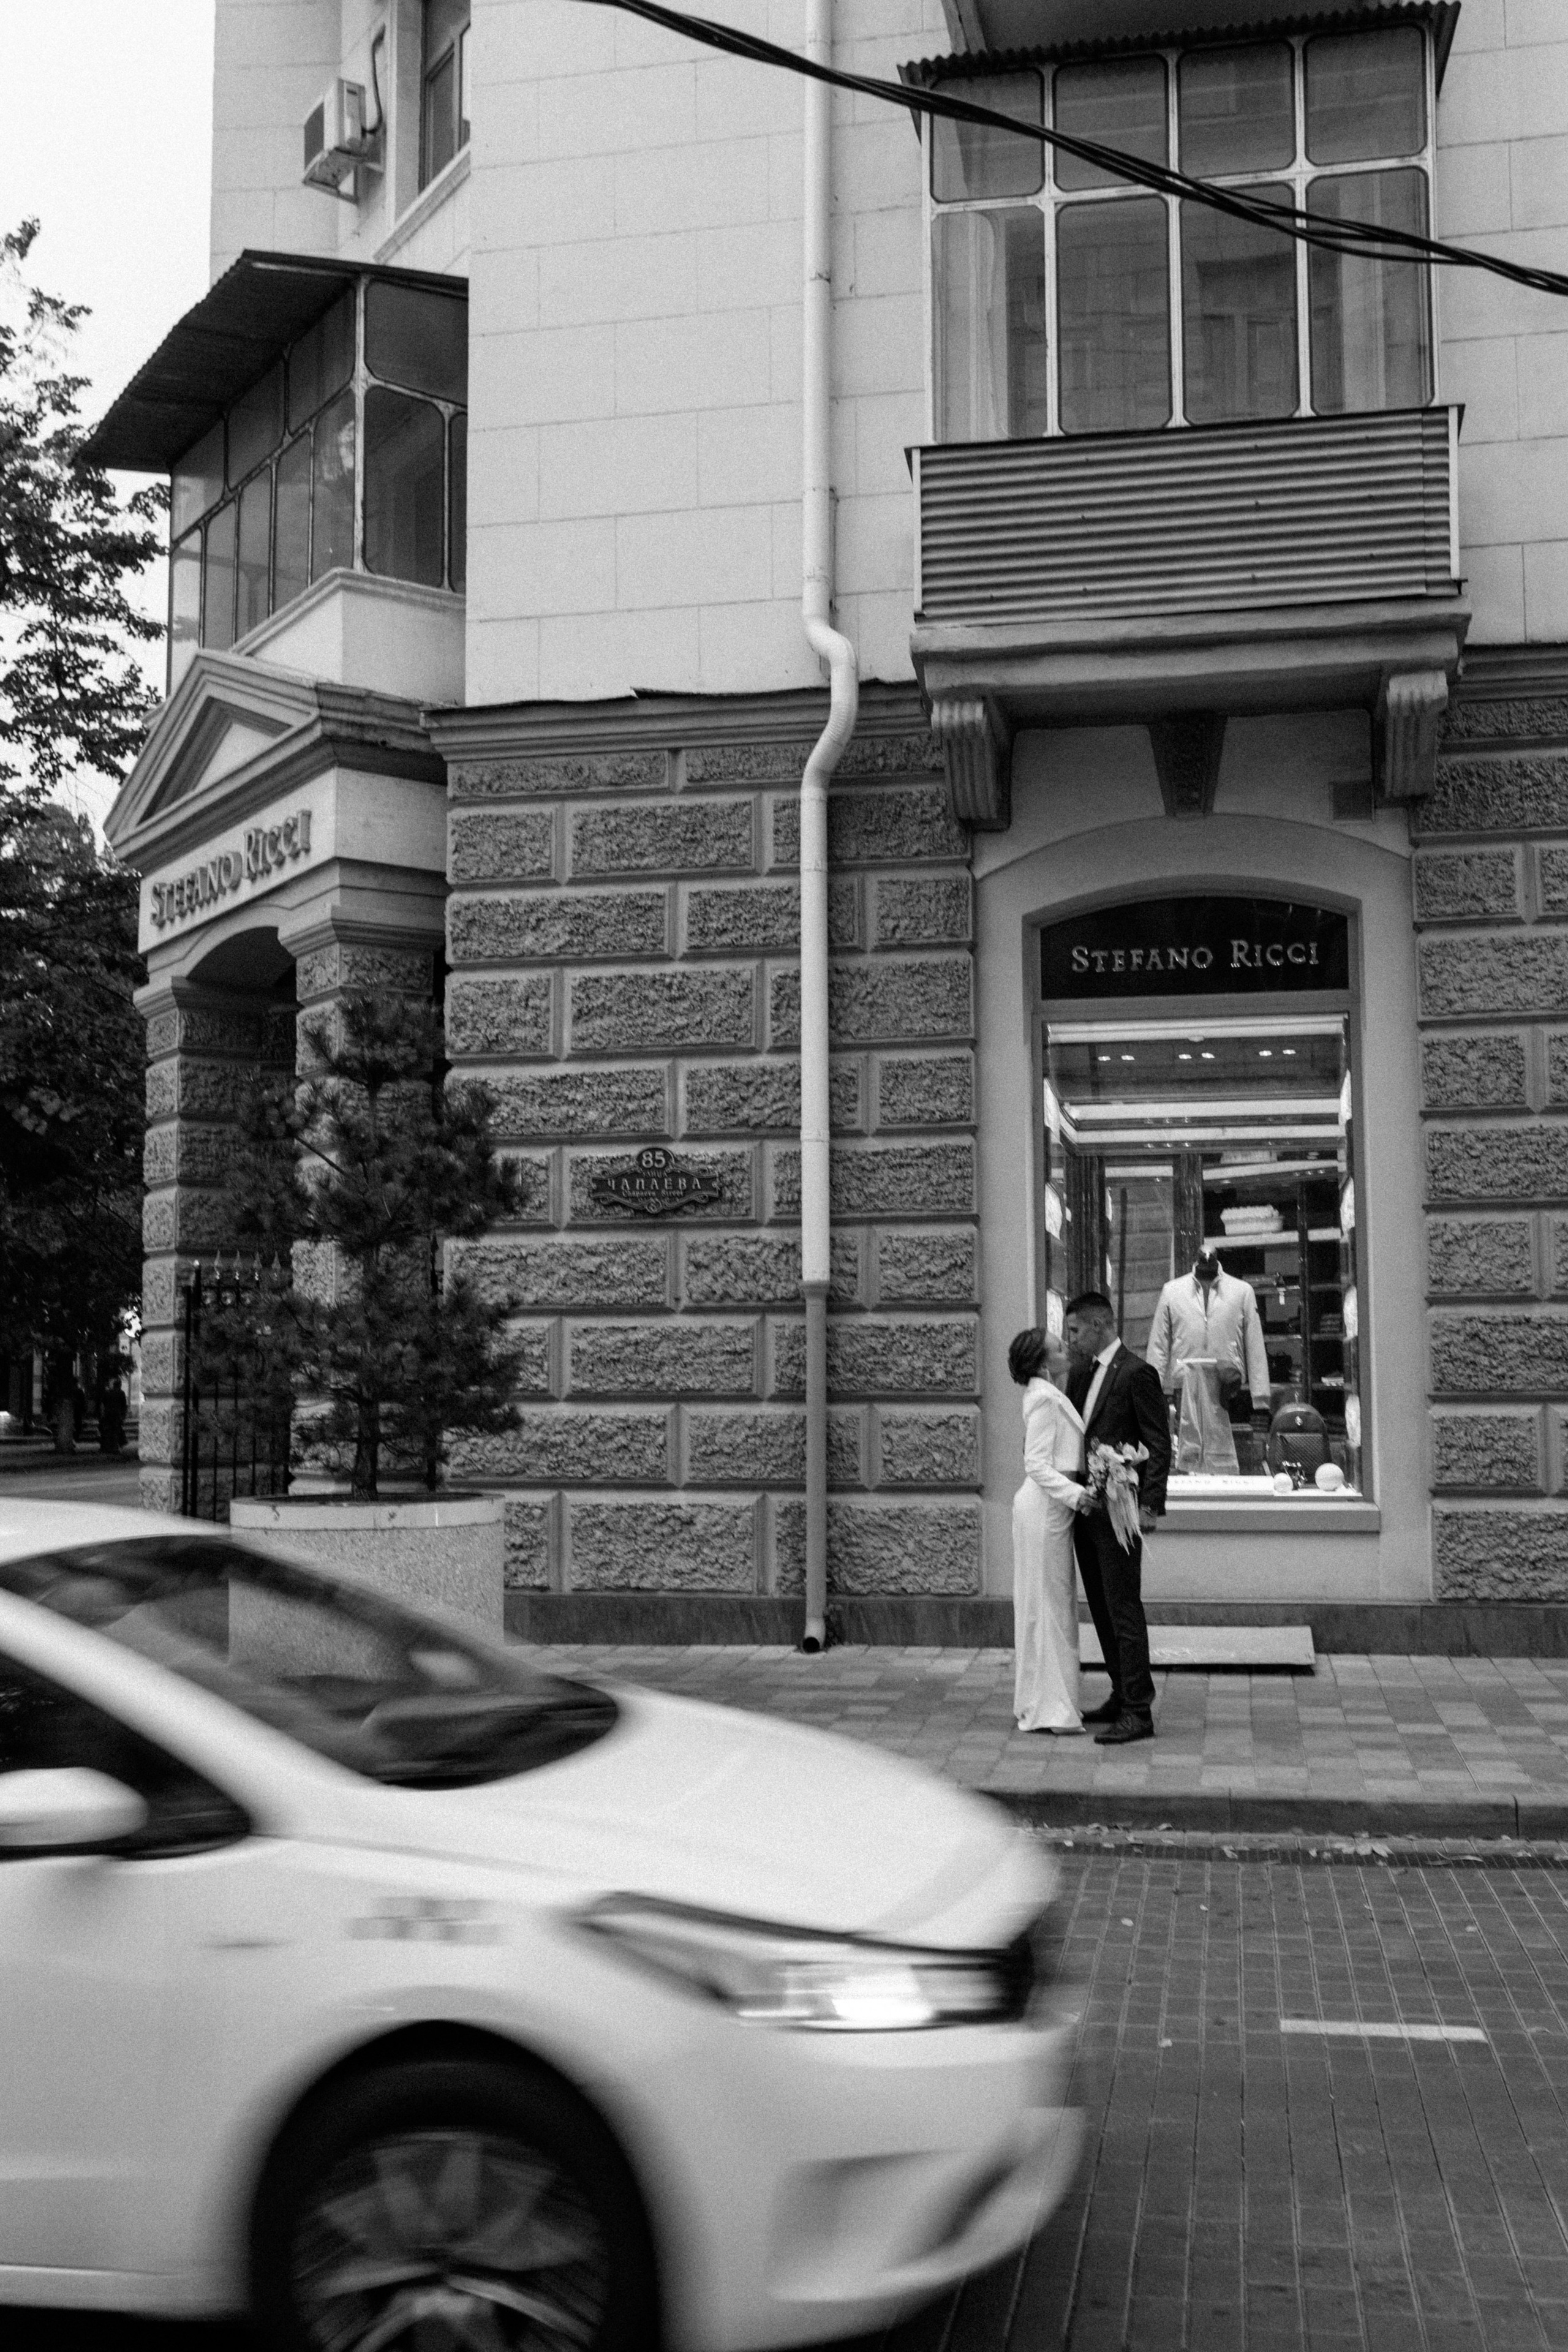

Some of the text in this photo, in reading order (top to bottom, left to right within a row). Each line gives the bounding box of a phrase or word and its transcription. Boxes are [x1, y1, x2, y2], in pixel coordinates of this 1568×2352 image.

[150, 810, 311, 928] STEFANO RICCI
[1071, 939, 1320, 973] STEFANO RICCI
[642, 1151, 666, 1168] 85
[608, 1178, 701, 1190] ЧАПАЕВА
[661, 1189, 684, 1197] Street
